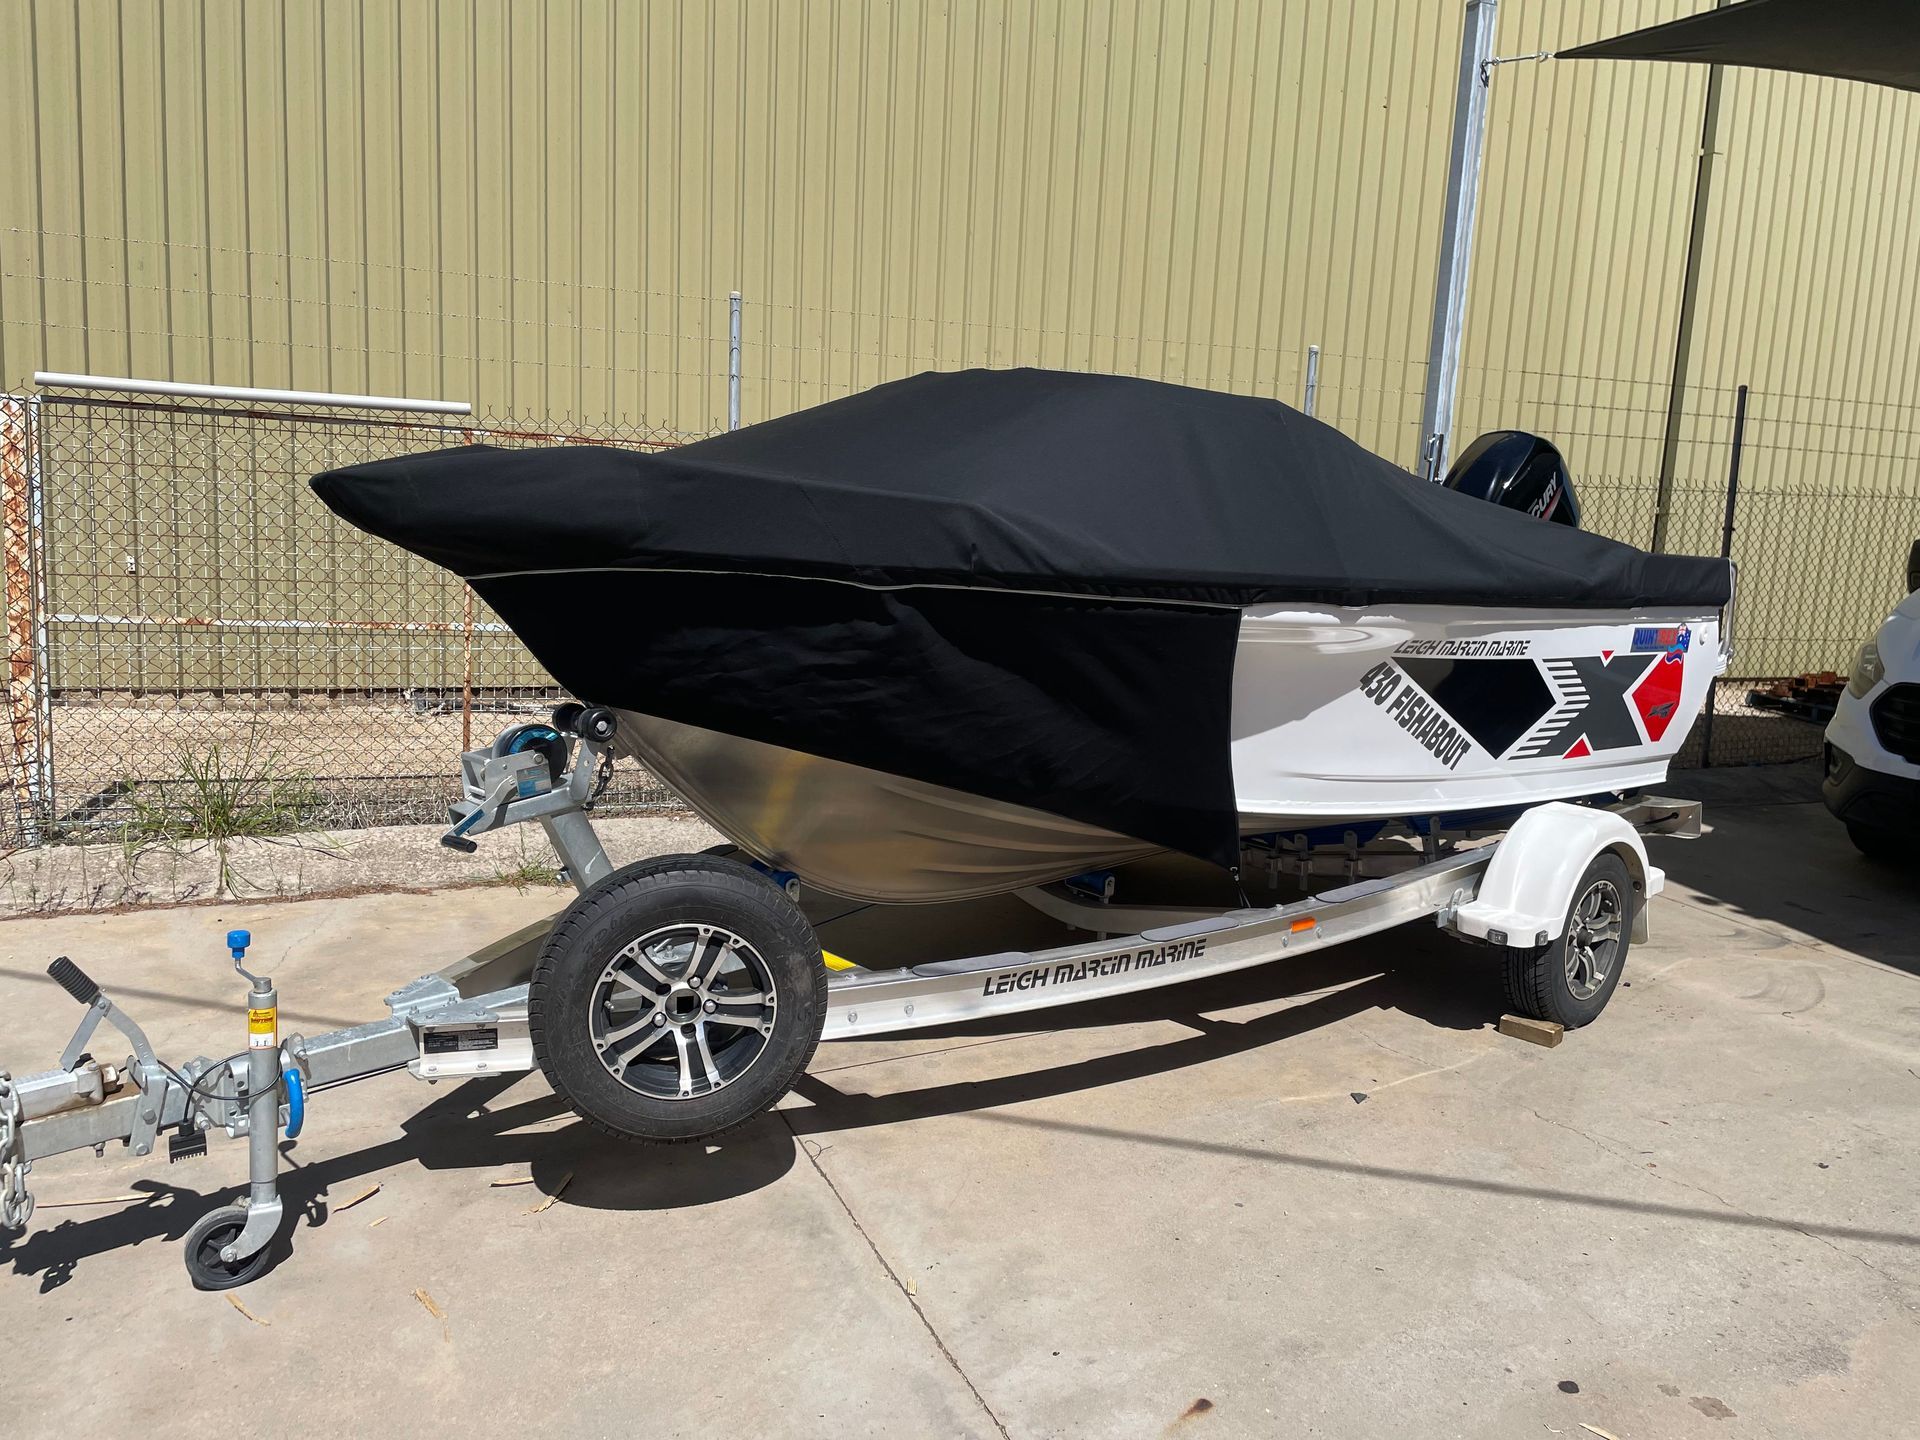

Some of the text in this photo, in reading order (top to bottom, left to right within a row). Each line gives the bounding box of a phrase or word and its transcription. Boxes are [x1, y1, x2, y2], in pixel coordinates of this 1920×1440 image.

[1393, 639, 1532, 657] LEIGH MARTIN MARINE
[1359, 661, 1472, 771] 430 FISHABOUT
[983, 938, 1207, 997] LEIGH MARTIN MARINE
